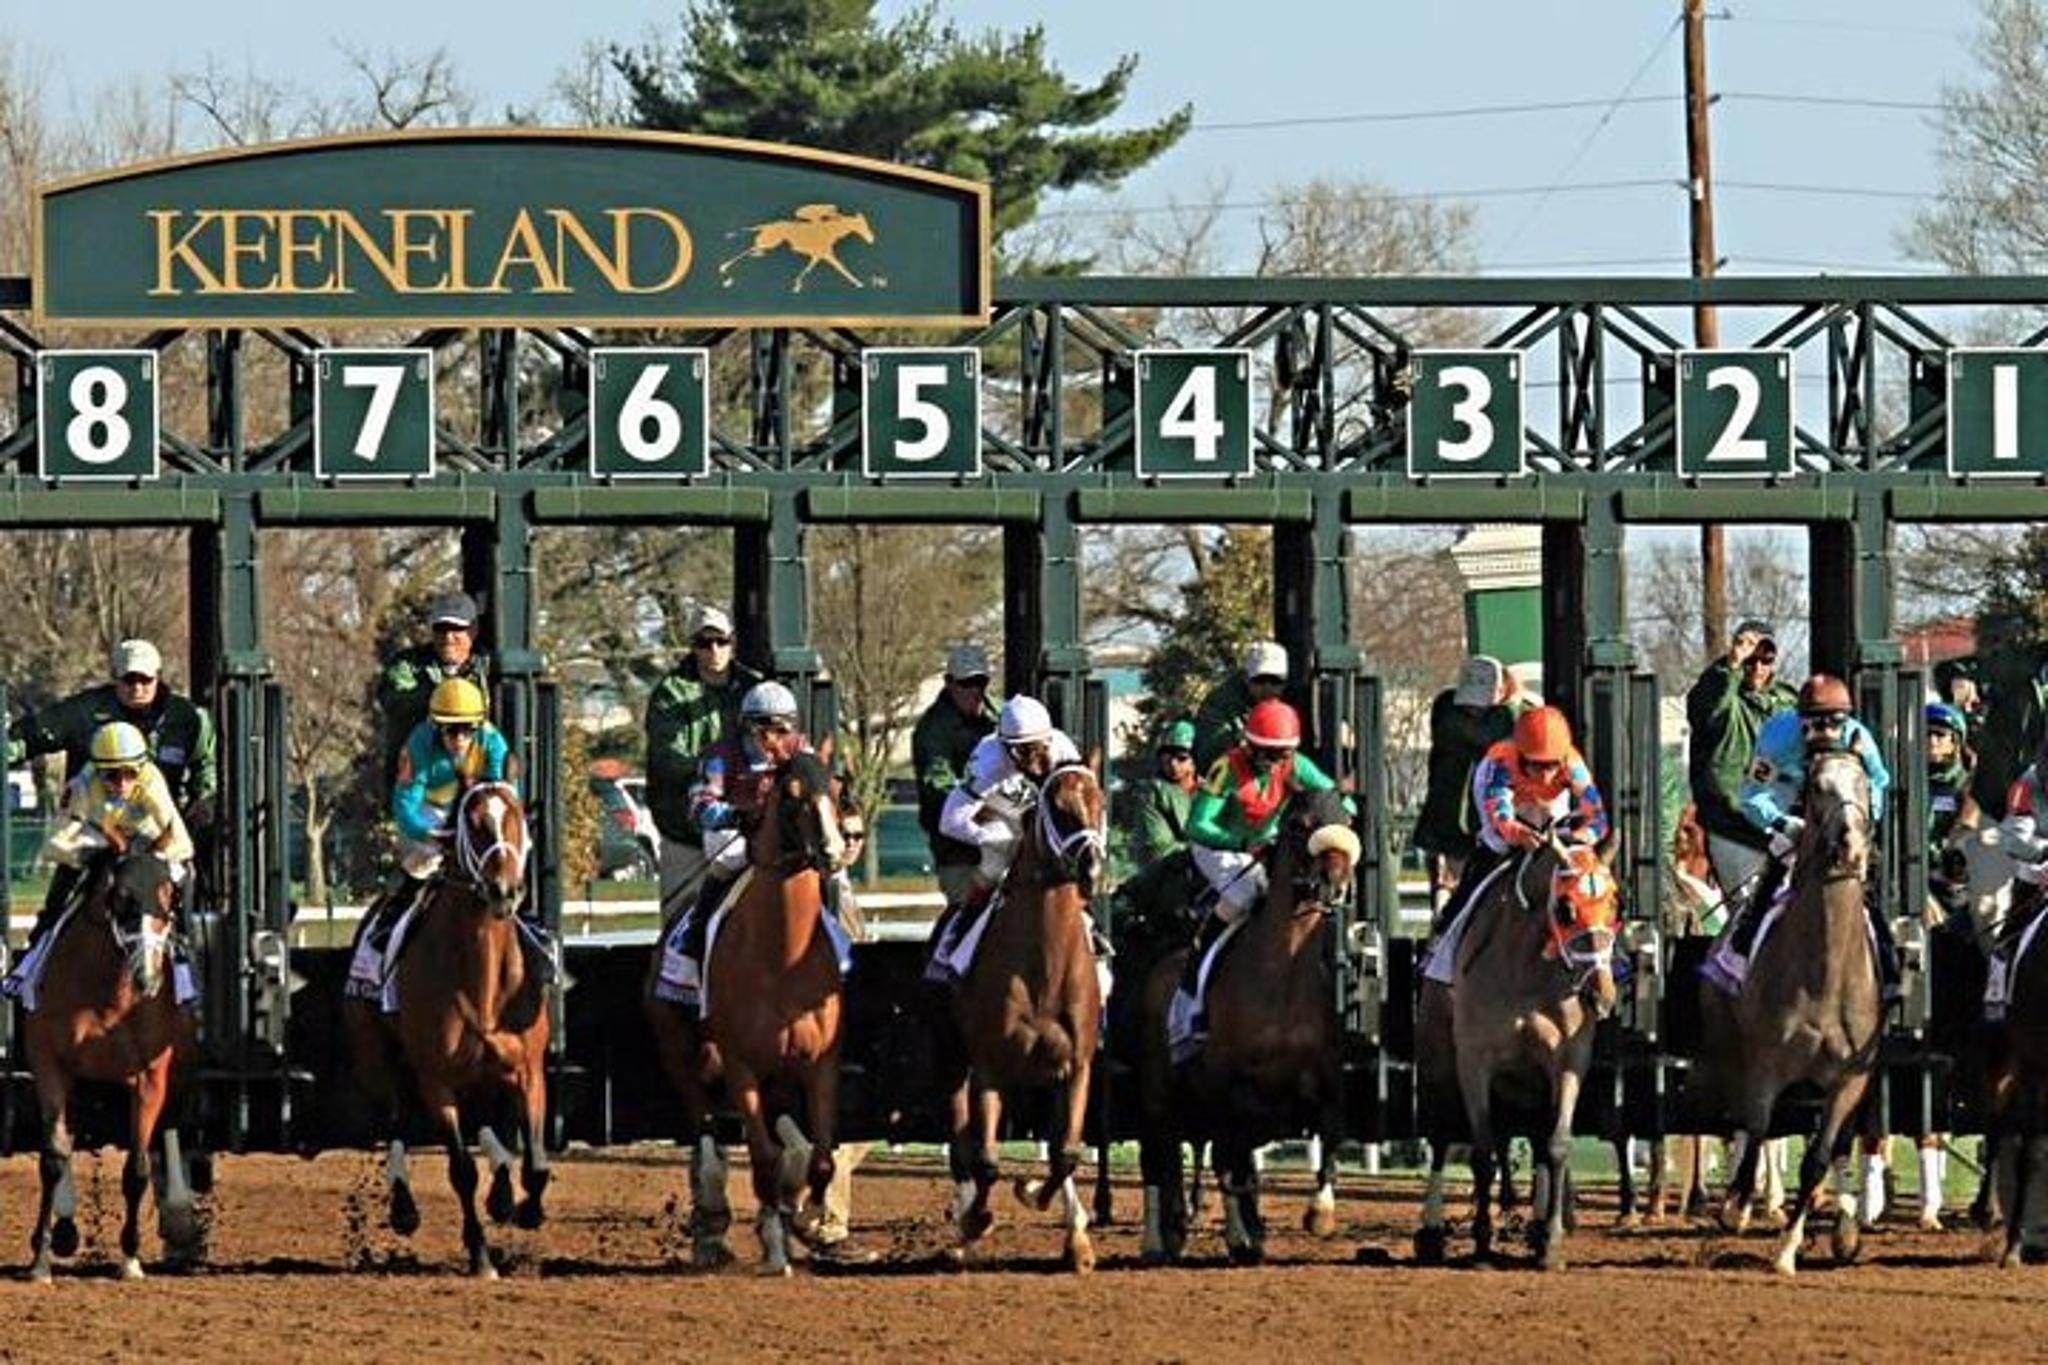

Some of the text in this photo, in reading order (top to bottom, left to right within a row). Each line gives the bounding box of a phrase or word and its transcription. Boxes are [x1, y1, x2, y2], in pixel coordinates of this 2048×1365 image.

[146, 208, 693, 295] KEENELAND
[66, 366, 132, 464] 8
[343, 365, 406, 462] 7
[618, 364, 682, 462] 6
[894, 364, 950, 461] 5
[1159, 365, 1225, 461] 4
[1437, 365, 1494, 462] 3
[1705, 365, 1768, 461] 2
[1993, 365, 2018, 459] 1
